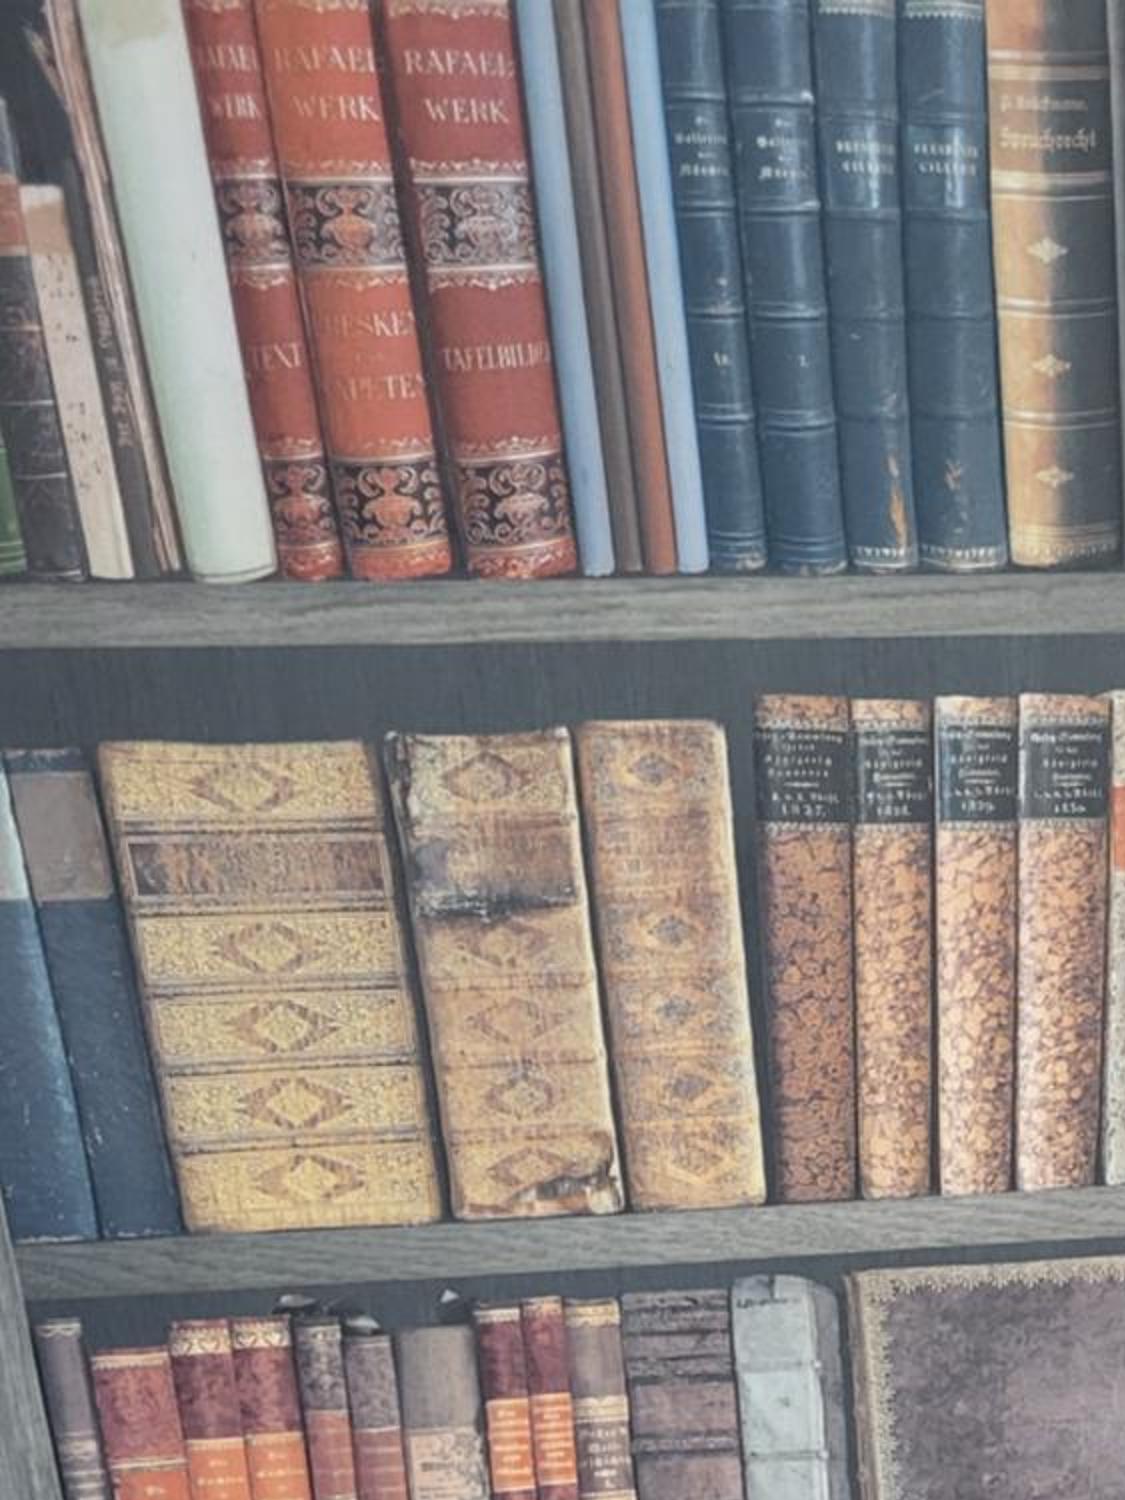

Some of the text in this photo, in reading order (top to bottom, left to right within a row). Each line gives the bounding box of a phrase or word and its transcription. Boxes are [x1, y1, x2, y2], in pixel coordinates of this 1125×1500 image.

[403, 48, 513, 78] RAFAEL
[290, 96, 382, 123] WERK
[424, 97, 510, 125] WERK
